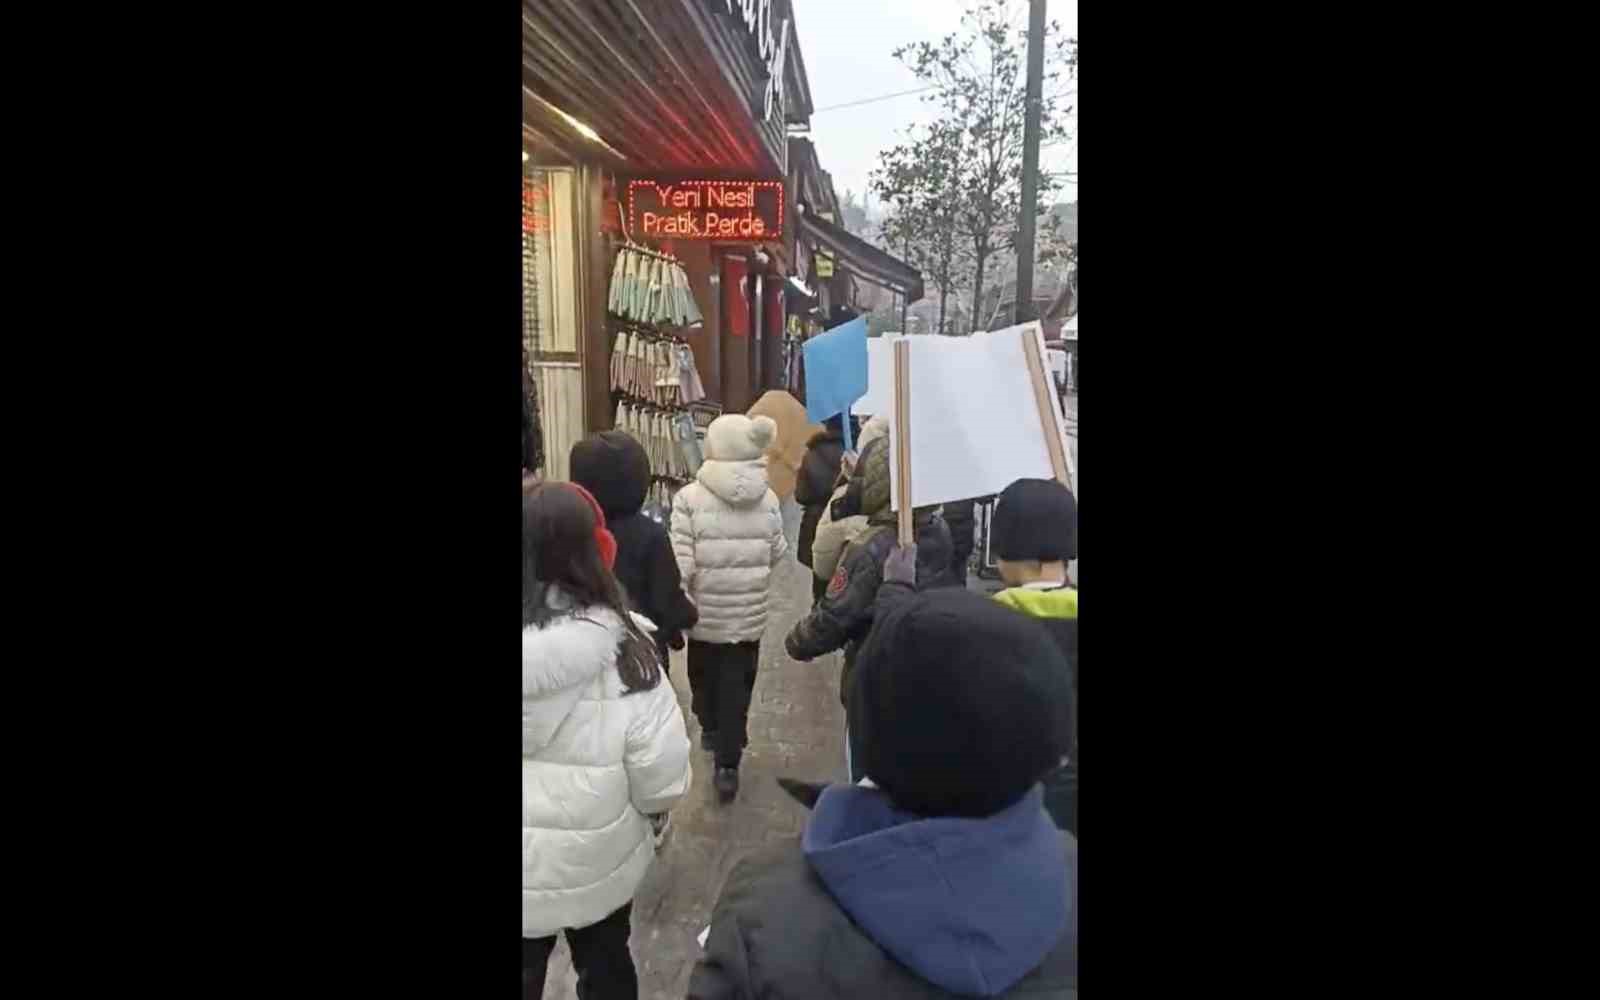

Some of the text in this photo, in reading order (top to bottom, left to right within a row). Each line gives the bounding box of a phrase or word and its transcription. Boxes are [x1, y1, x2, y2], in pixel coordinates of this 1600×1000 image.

[657, 184, 754, 207] Yeni Nesil
[642, 211, 763, 234] Pratik Perde
